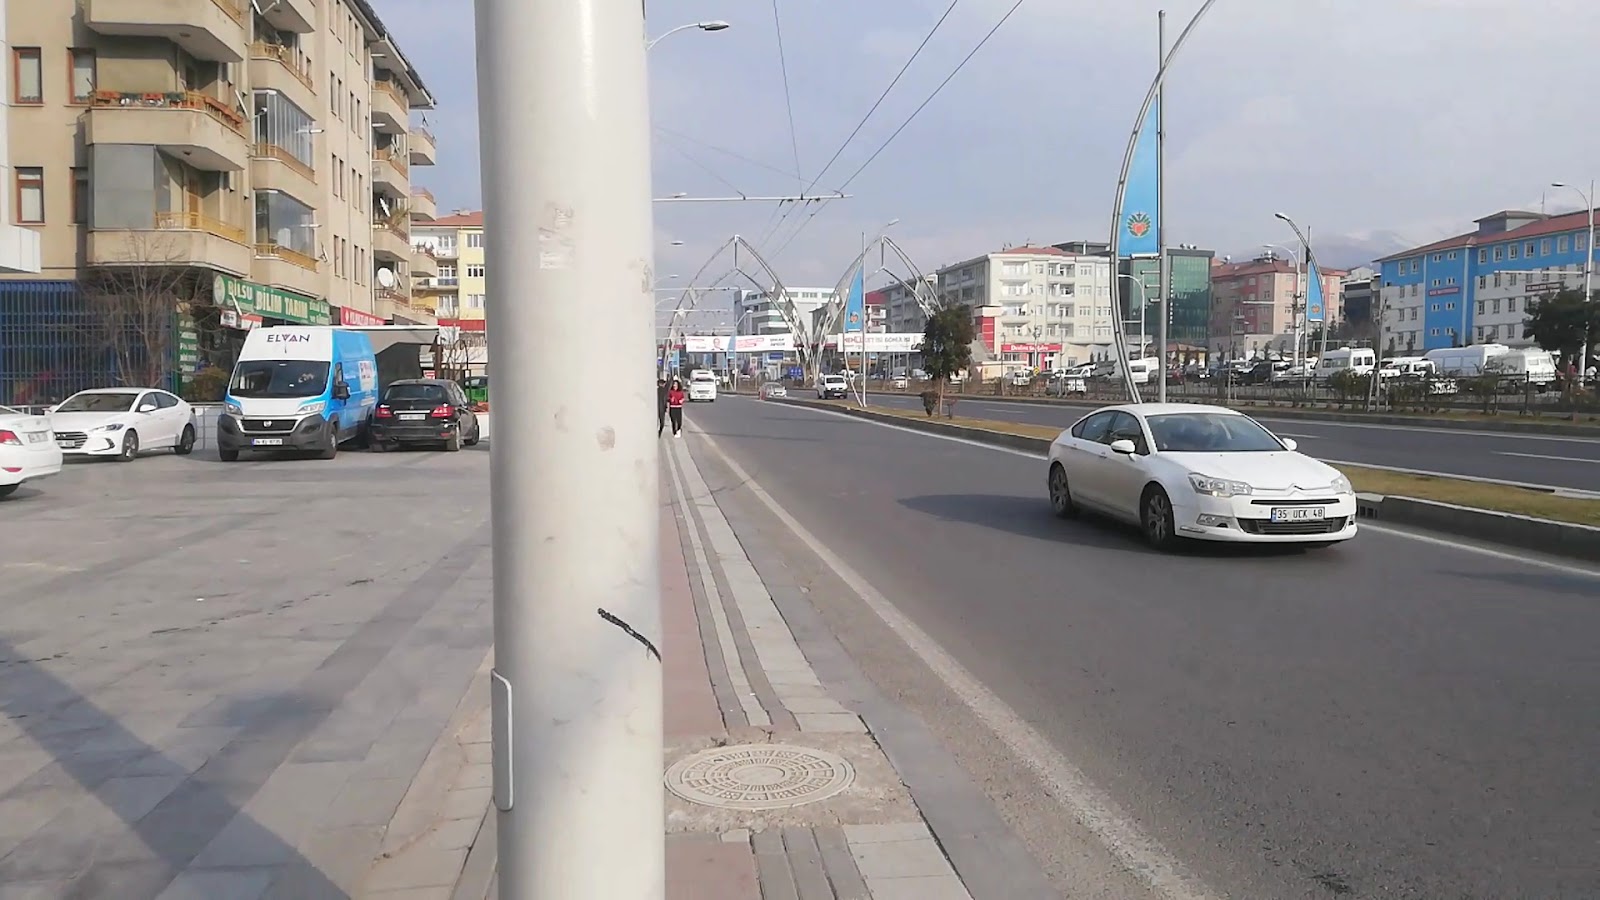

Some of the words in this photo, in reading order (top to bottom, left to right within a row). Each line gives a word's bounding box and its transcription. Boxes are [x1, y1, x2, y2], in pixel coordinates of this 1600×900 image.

[228, 280, 253, 300] BİLSU
[256, 287, 282, 313] BİLİM
[285, 297, 308, 319] TARIM
[267, 333, 311, 343] ELVAN
[1277, 509, 1287, 518] 35
[1293, 509, 1307, 518] UCK
[1313, 509, 1322, 517] 48
